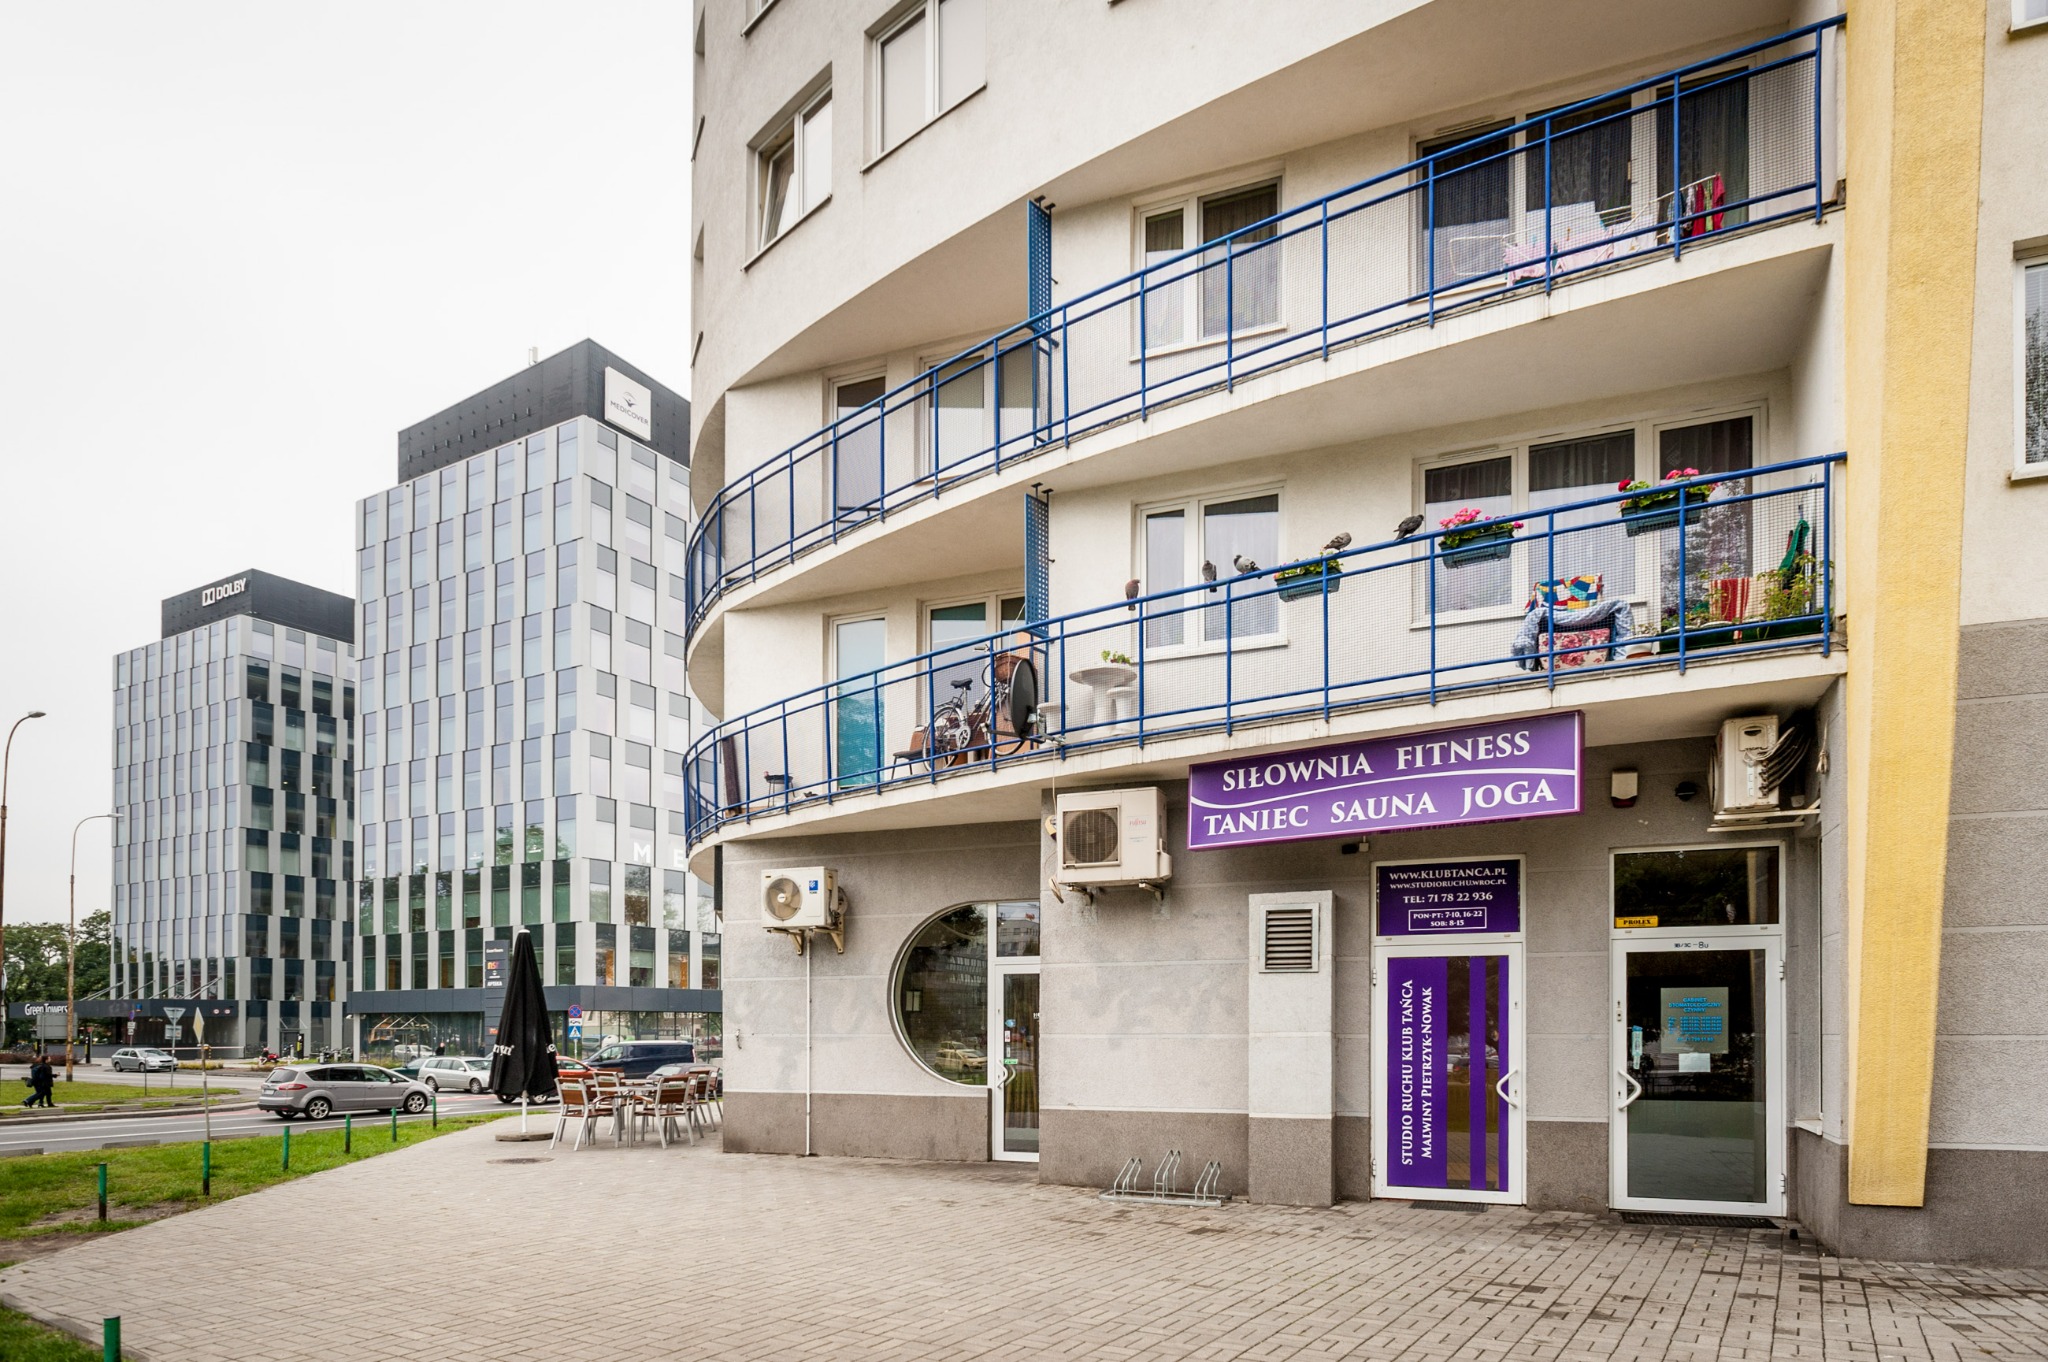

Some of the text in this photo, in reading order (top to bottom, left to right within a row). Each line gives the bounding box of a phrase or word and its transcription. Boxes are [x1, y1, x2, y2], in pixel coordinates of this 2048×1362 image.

[610, 400, 649, 425] MEDICOVER
[216, 577, 247, 600] DOLBY
[1222, 730, 1531, 792] SIŁOWNIA FITNESS
[1203, 778, 1558, 837] TANIEC SAUNA JOGA
[1389, 867, 1508, 880] WWW.KLUBTANCA.PL
[1403, 892, 1493, 903] TEL: 71 78 22 936
[1413, 912, 1444, 920] PON-PT:
[1463, 910, 1483, 918] 16-22
[24, 1003, 68, 1016] Green Towers
[1399, 980, 1413, 1166] STUDIO RUCHU KLUB TAŃCA
[1421, 986, 1433, 1158] MALWINY PIETRZYK-NOWAK
